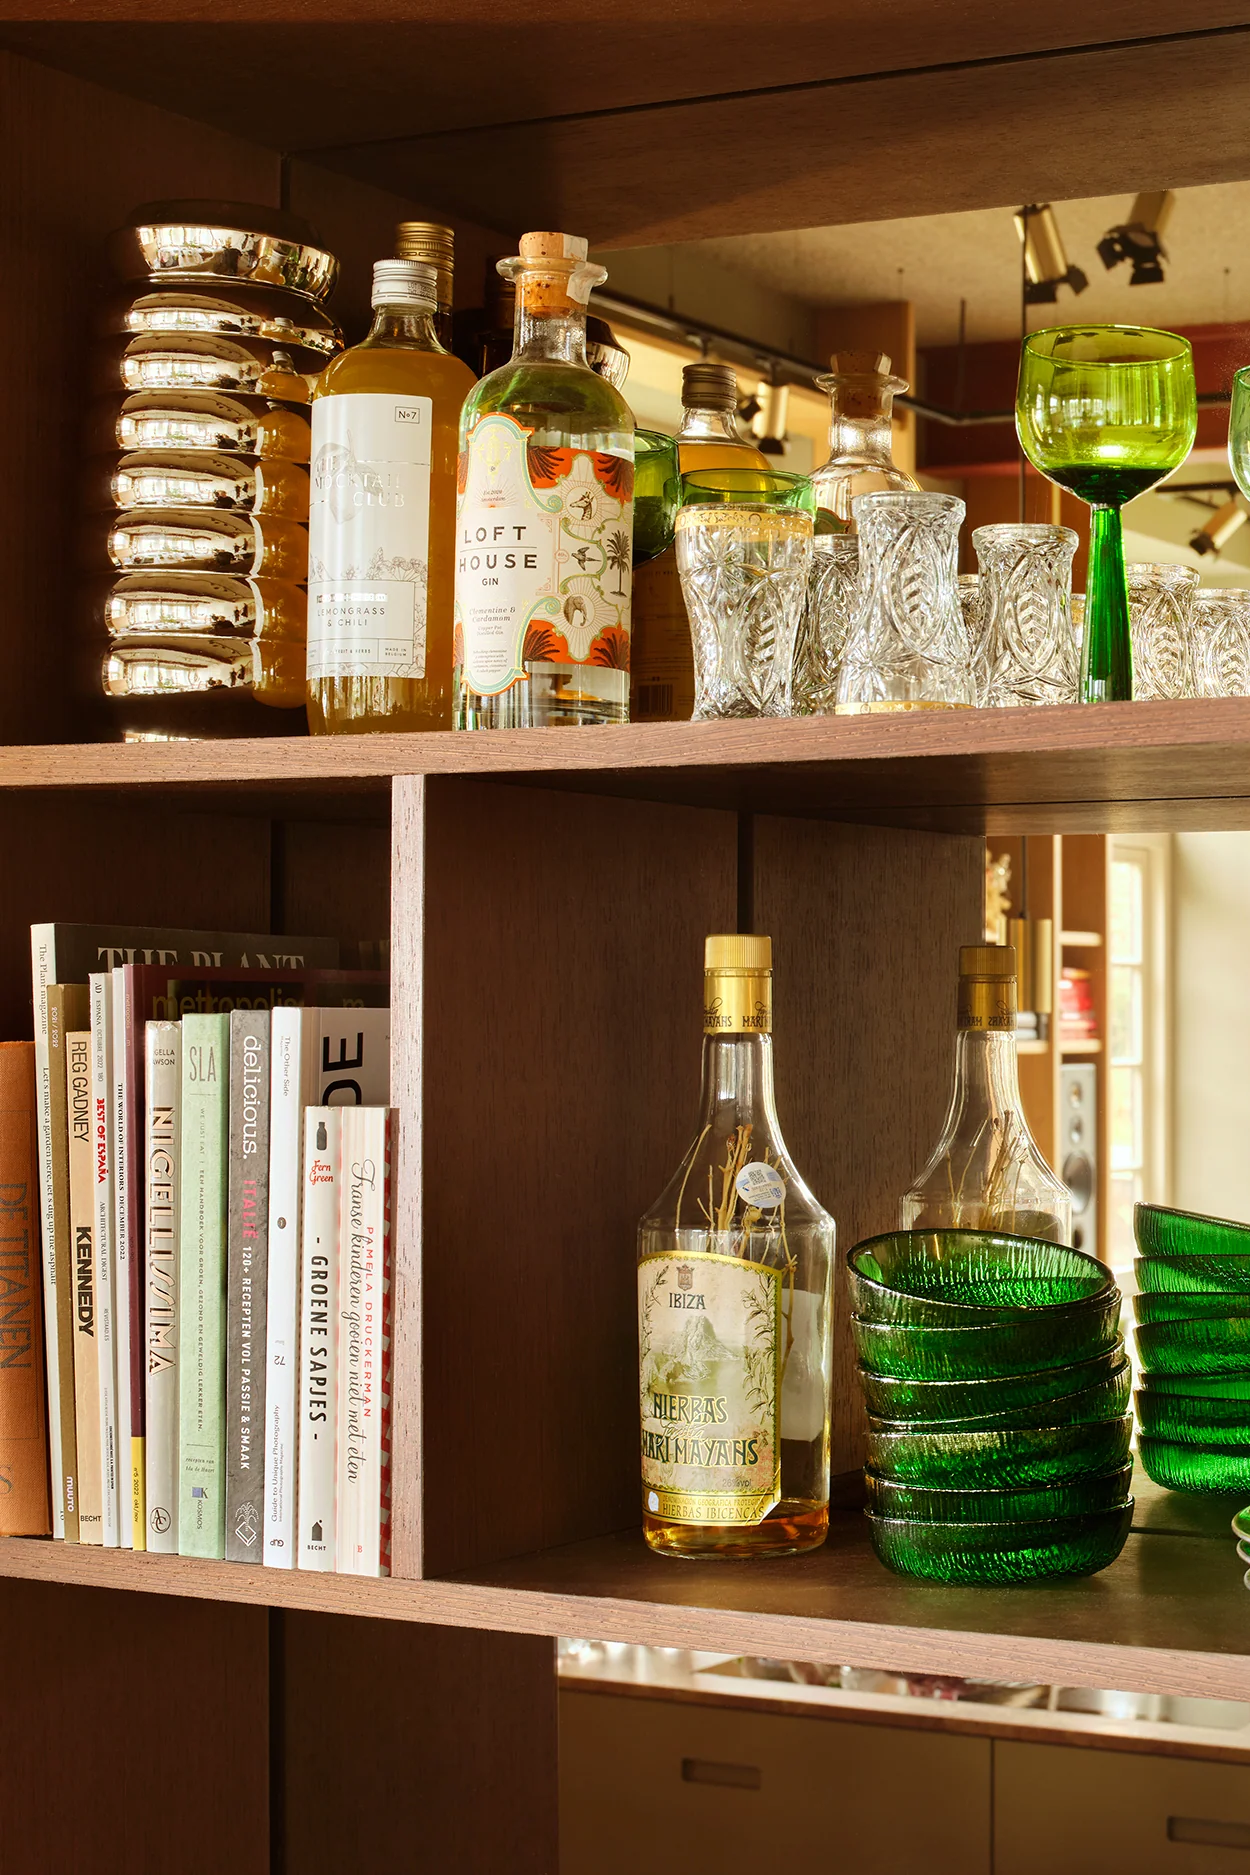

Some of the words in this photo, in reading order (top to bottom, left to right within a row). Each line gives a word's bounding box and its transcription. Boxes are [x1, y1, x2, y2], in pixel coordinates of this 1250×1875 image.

[353, 492, 405, 507] CLUB
[464, 526, 527, 544] LOFT
[459, 554, 537, 573] HOUSE
[482, 578, 499, 586] GIN
[317, 607, 385, 616] LEMONGRASS
[39, 944, 47, 961] The
[40, 964, 48, 988] Plant
[39, 989, 47, 1034] magazine
[95, 1000, 103, 1025] ESPAÑA
[72, 1041, 87, 1073] REG
[189, 1046, 216, 1081] SLA
[72, 1081, 89, 1143] GADNEY
[97, 1098, 105, 1123] BEST
[200, 1108, 205, 1118] WE
[243, 1035, 261, 1160] delicious.
[43, 1125, 52, 1157] garden
[97, 1125, 105, 1141] OF
[118, 1134, 124, 1144] OF
[98, 1143, 108, 1183] ESPAÑA
[309, 1170, 334, 1186] Green
[311, 1160, 331, 1172] Fern
[0, 1183, 27, 1221] DE
[242, 1179, 259, 1238] ITALIË
[350, 1158, 376, 1229] Franse
[46, 1221, 54, 1233] up
[99, 1201, 107, 1257] ARCHITECTURAL
[149, 1106, 176, 1377] NIGELLISSIMA
[242, 1246, 252, 1273] 120+
[350, 1232, 371, 1308] kinderen
[365, 1227, 375, 1292] PAMELA
[76, 1226, 94, 1337] KENNEDY
[310, 1256, 329, 1336] GROENE
[0, 1229, 31, 1368] TITANEN
[242, 1278, 251, 1338] RECEPTEN
[669, 1292, 706, 1310] IBIZA
[198, 1324, 203, 1334] EN
[341, 1311, 363, 1368] gooien
[241, 1342, 251, 1364] VOL
[274, 1355, 286, 1366] 72
[363, 1302, 373, 1417] DRUCKERMAN
[241, 1369, 250, 1411] PASSIE
[309, 1347, 327, 1422] SAPJES
[348, 1371, 368, 1406] niet
[241, 1415, 250, 1423] &
[653, 1392, 728, 1423] HIERBAS
[348, 1409, 367, 1444] met
[240, 1427, 250, 1470] SMAAK
[674, 1439, 759, 1466] MAYANS
[271, 1457, 279, 1486] Unique
[347, 1447, 367, 1483] eten
[272, 1487, 278, 1496] to
[662, 1504, 702, 1519] HIERBAS
[706, 1506, 765, 1519] IBICENCAS
